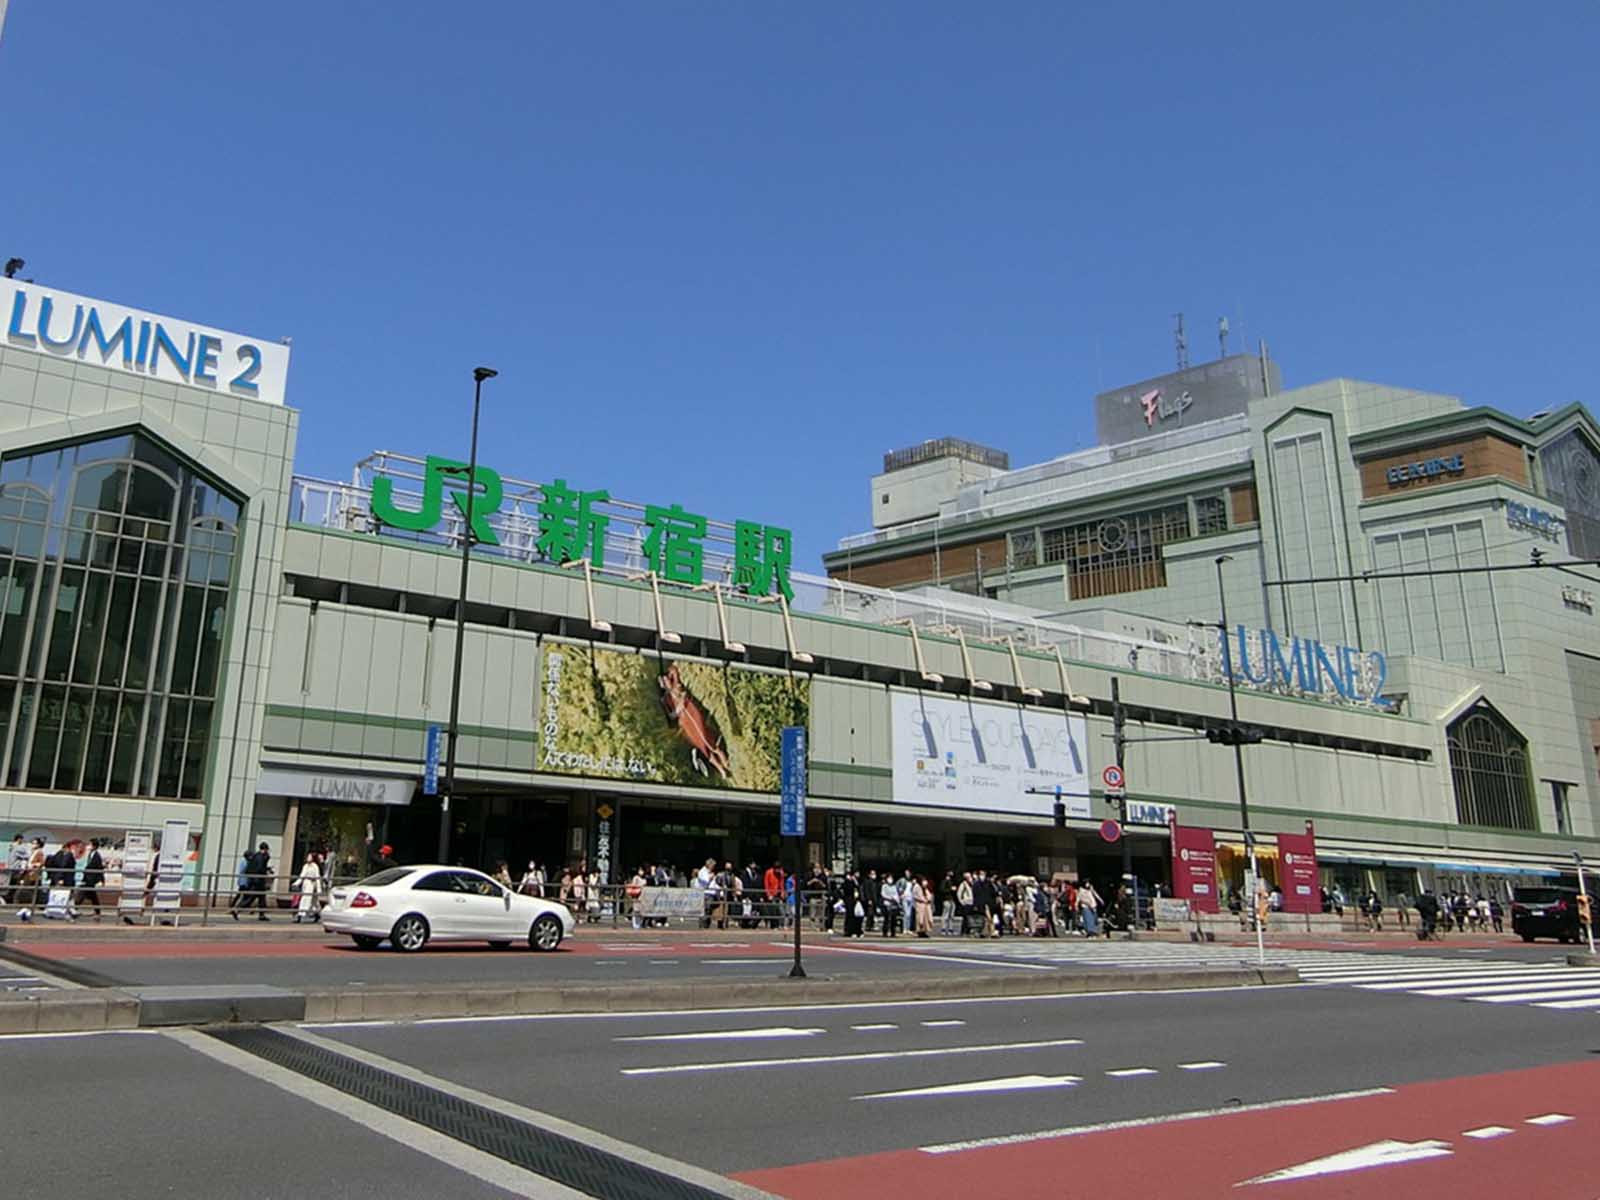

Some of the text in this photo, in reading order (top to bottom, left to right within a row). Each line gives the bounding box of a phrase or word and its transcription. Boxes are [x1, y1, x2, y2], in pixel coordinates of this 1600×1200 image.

[8, 289, 262, 397] LUMINE 2
[371, 455, 795, 600] JR 新宿駅
[1220, 621, 1393, 707] LUMINE 2
[311, 778, 386, 800] LUMINE 2
